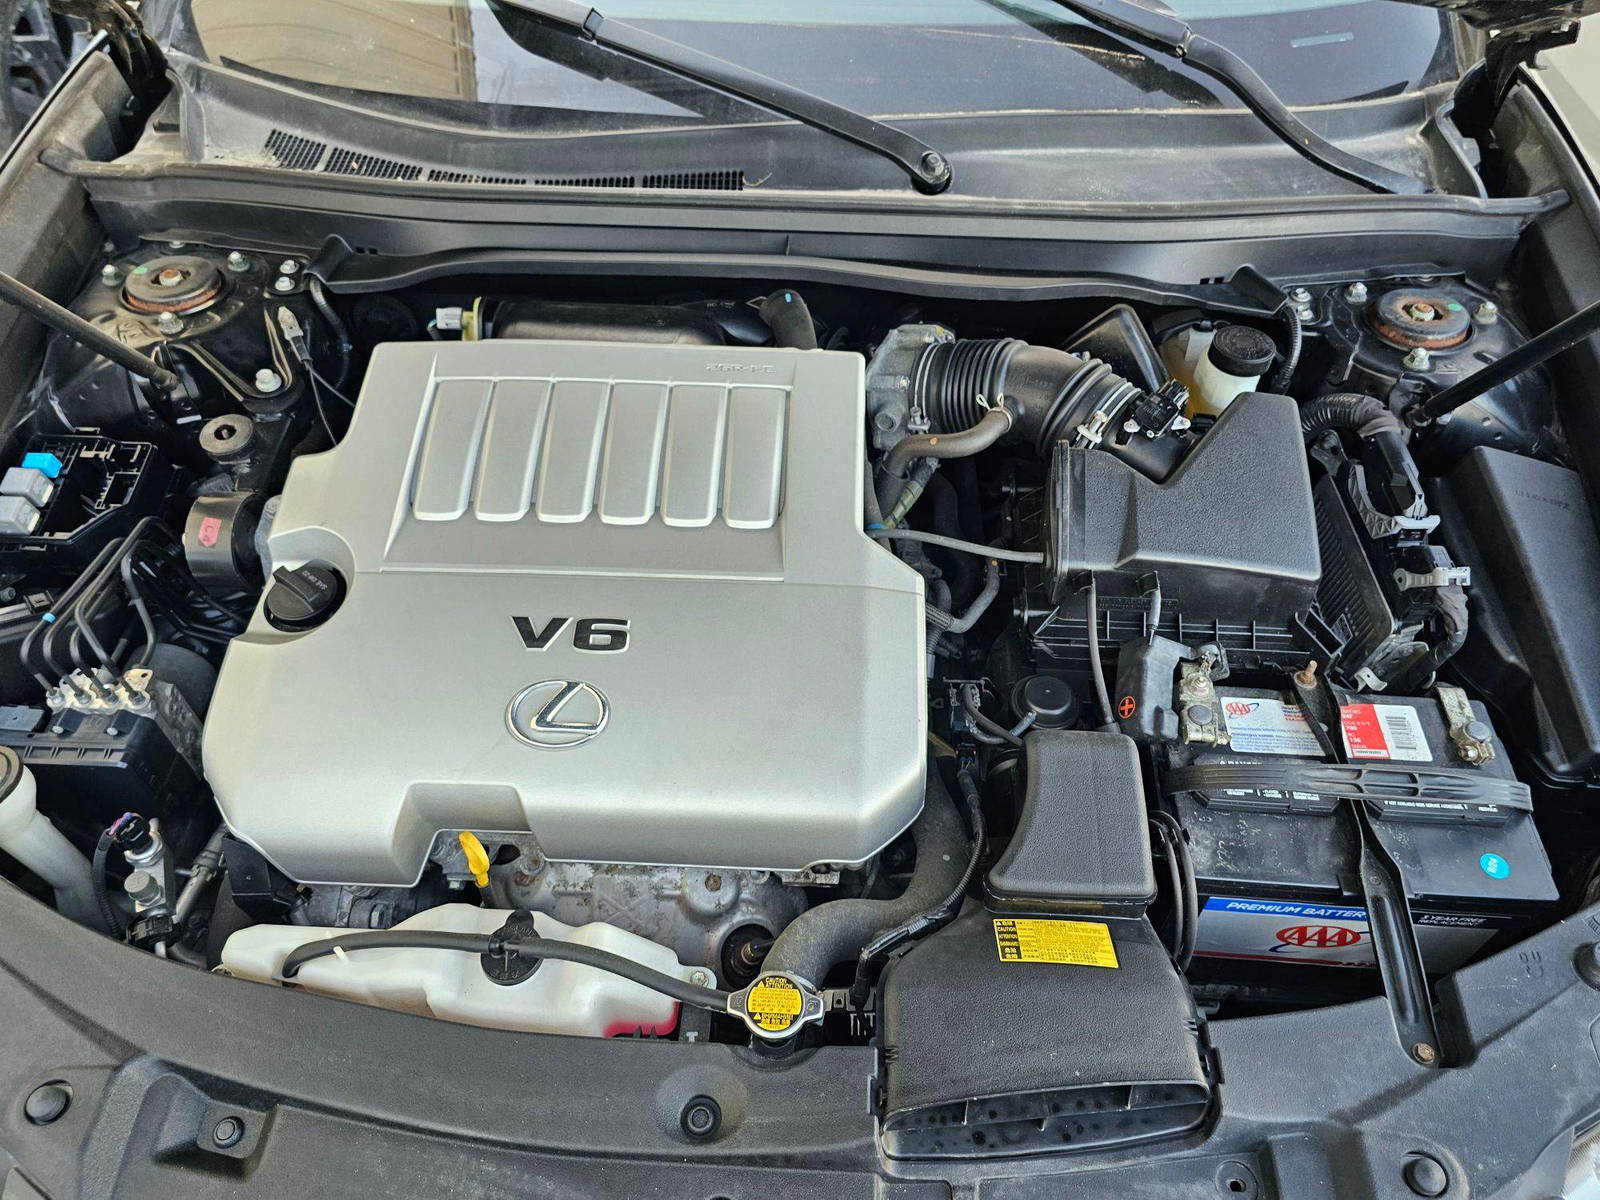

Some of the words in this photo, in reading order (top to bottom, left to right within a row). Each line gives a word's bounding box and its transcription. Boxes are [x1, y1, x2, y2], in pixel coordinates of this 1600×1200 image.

[511, 616, 630, 654] V6
[1226, 702, 1252, 715] AAA
[1226, 902, 1302, 914] PREMIUM
[1303, 907, 1367, 919] BATTER
[1281, 925, 1355, 948] AAA
